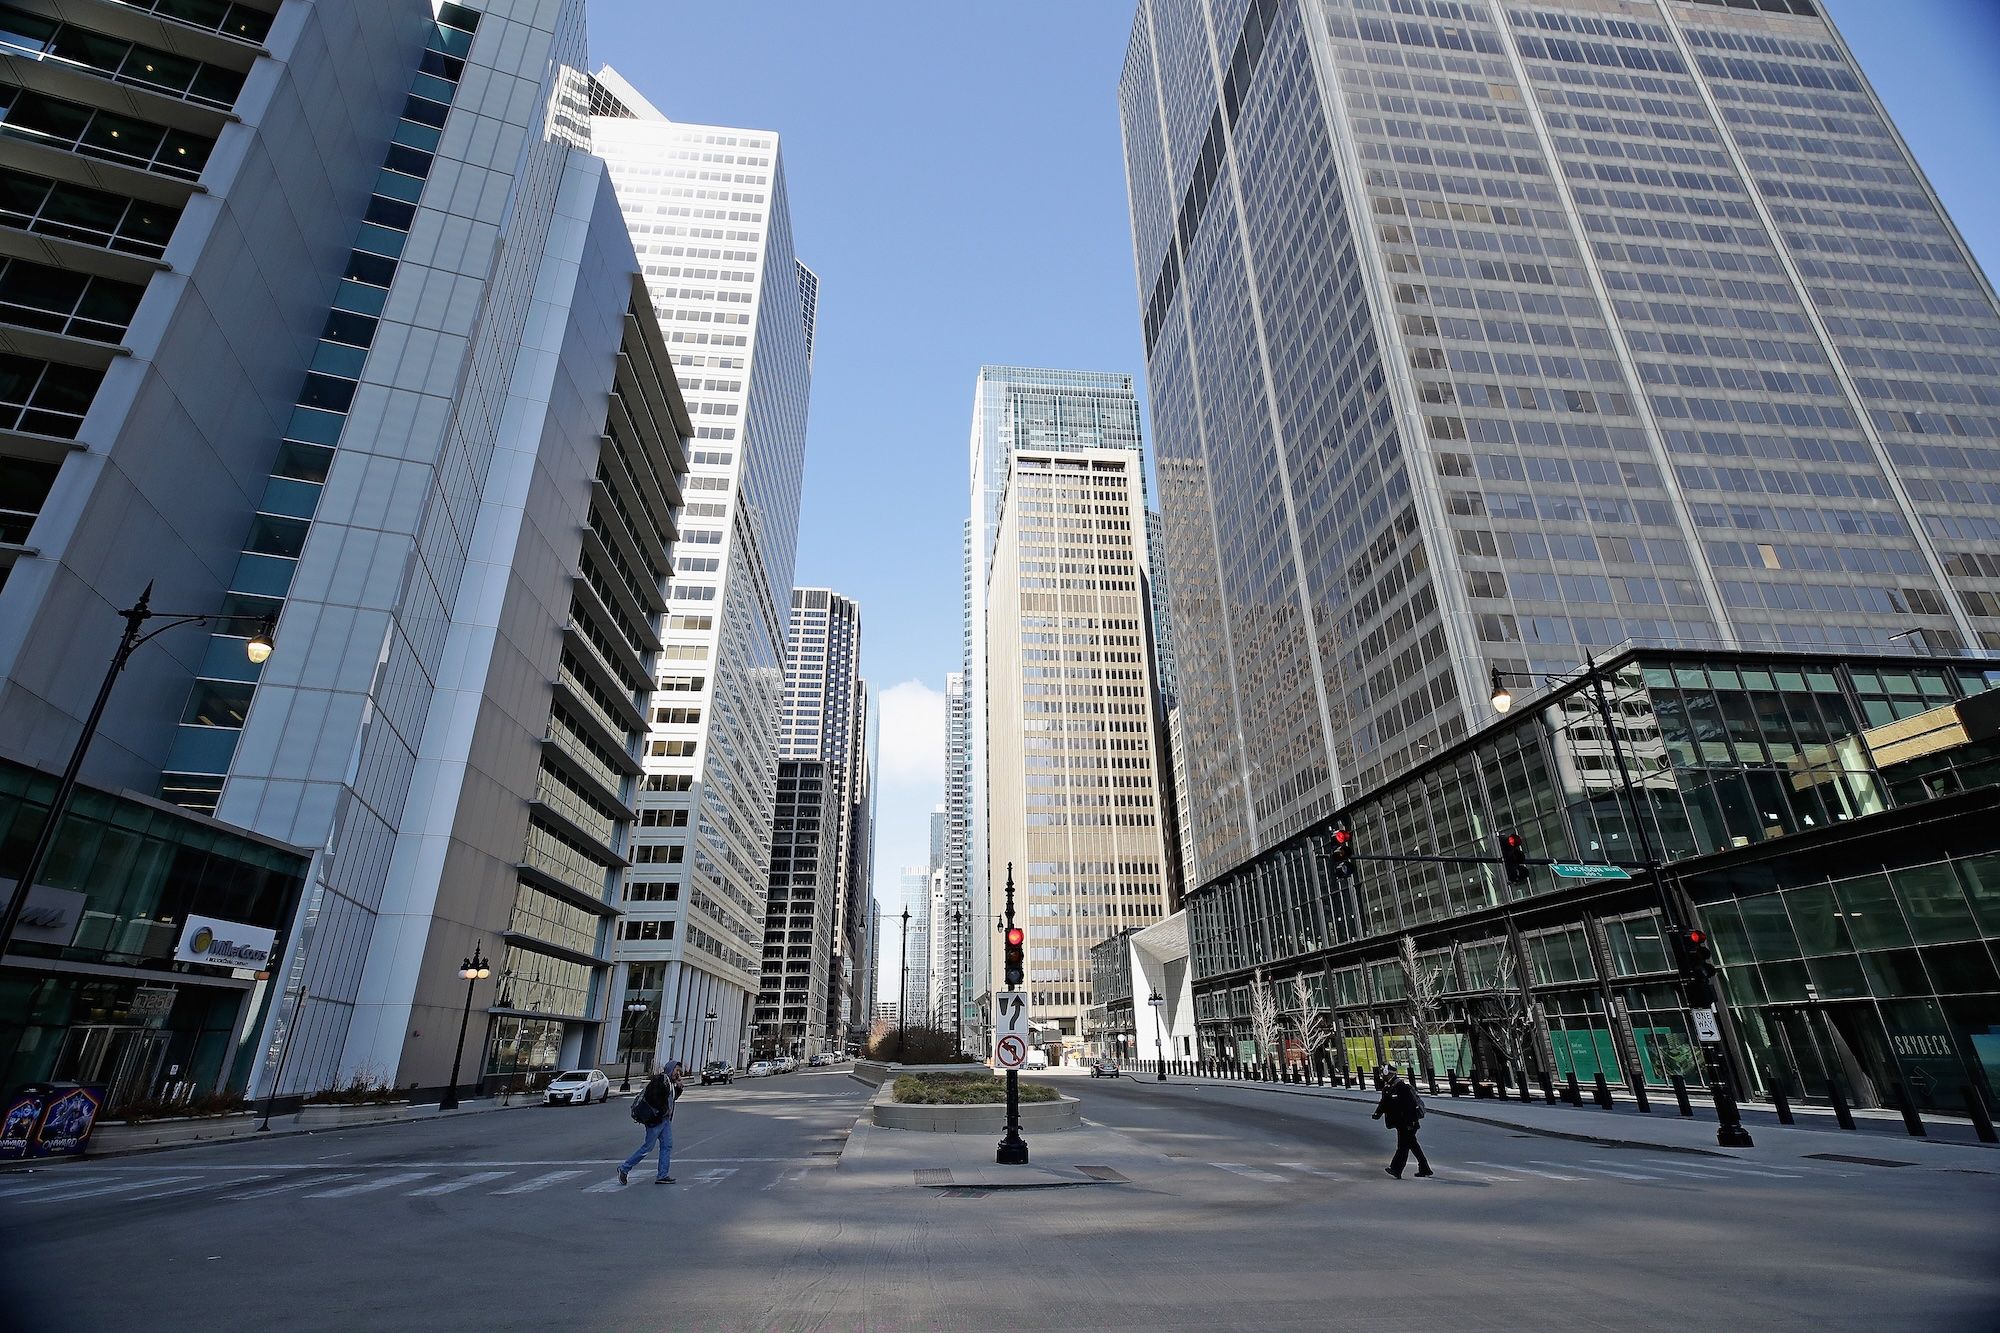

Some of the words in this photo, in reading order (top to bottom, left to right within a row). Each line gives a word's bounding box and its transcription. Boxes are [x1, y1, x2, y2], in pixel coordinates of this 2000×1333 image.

[208, 939, 268, 961] MillerCoors
[1696, 1012, 1711, 1020] ONE
[1697, 1020, 1712, 1028] WAY
[1895, 1035, 1951, 1055] SKYDECK
[42, 1138, 77, 1149] ONWARD
